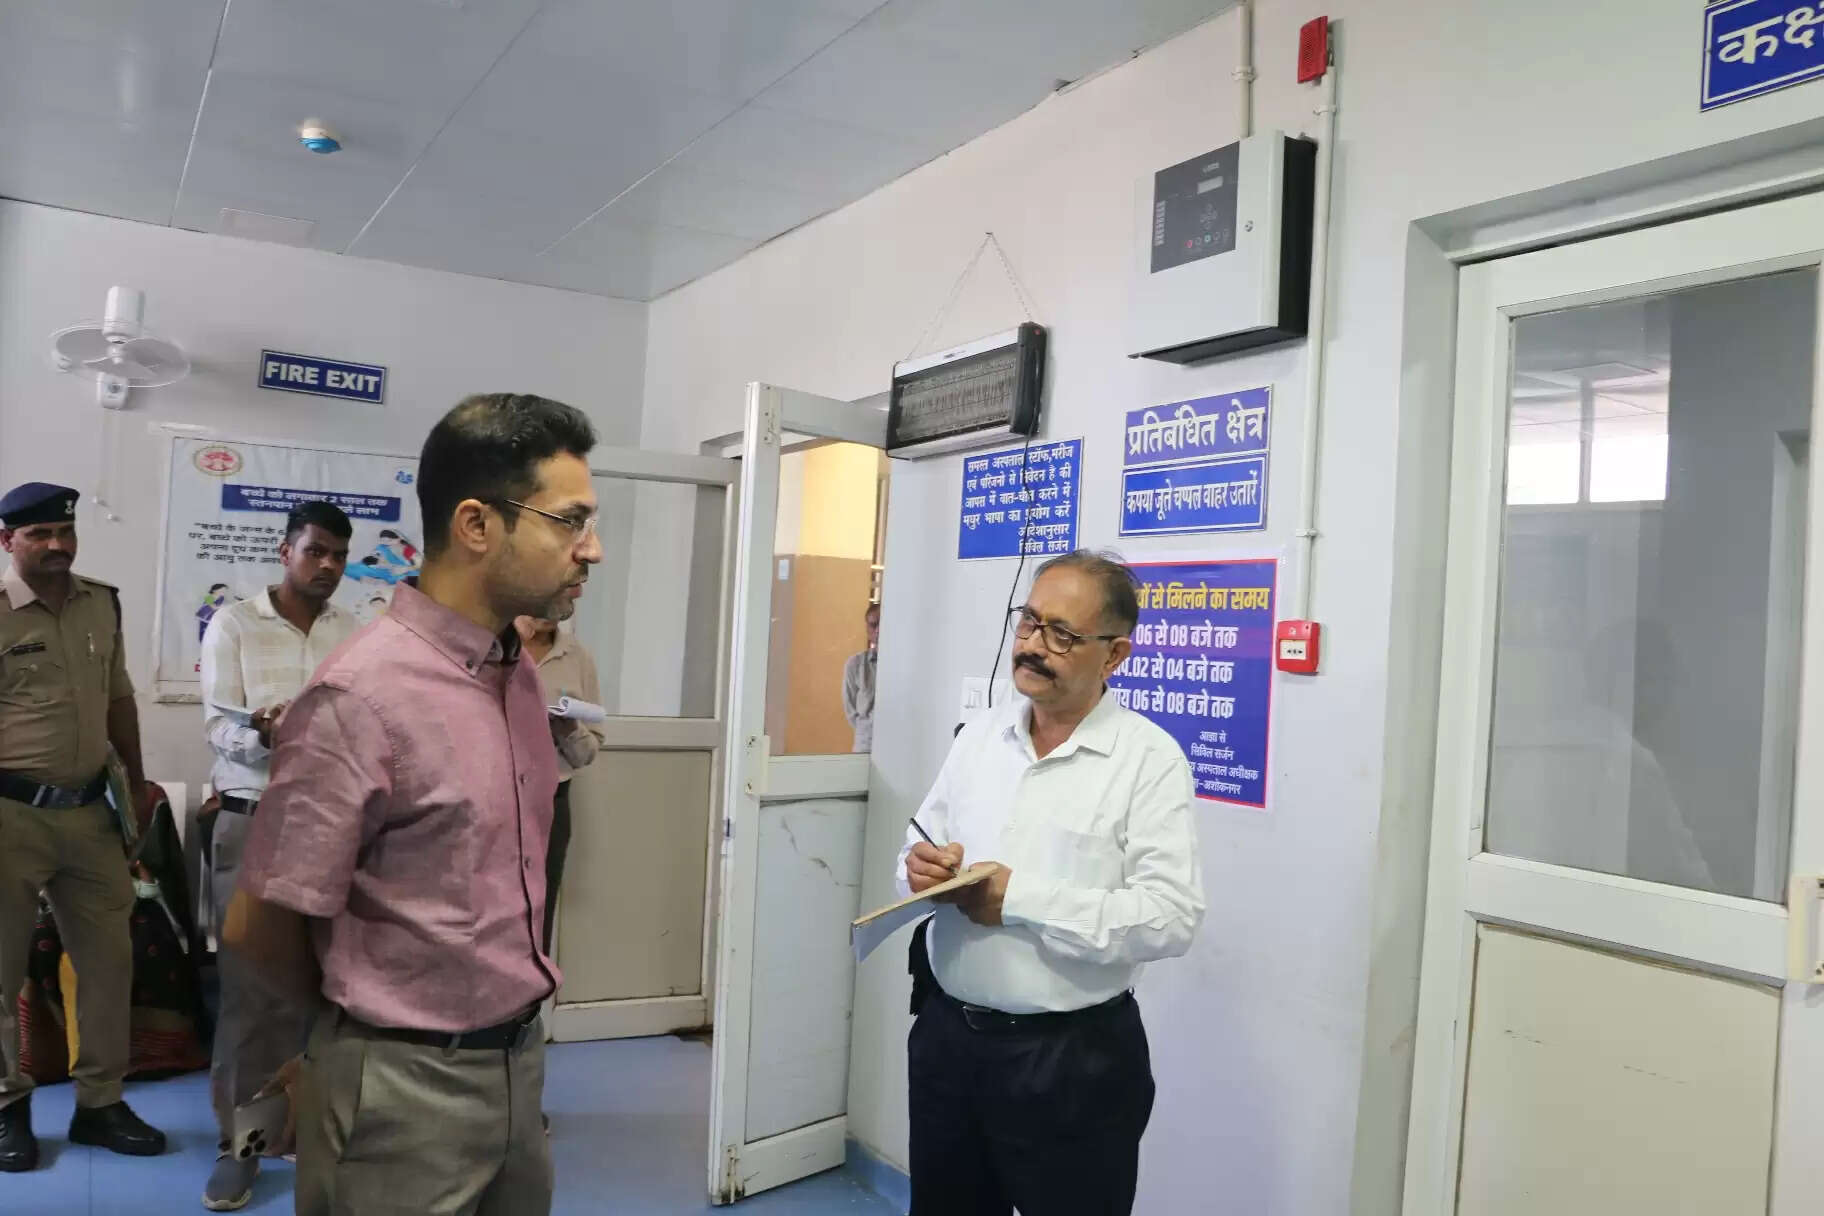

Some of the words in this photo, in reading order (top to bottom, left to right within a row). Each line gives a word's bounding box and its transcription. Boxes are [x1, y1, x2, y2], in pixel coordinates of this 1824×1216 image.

[265, 361, 319, 384] FIRE
[326, 370, 380, 392] EXIT
[1226, 399, 1265, 444] क्षेत्र
[1009, 470, 1016, 484] से
[1060, 462, 1072, 478] की
[1039, 483, 1059, 499] करने
[1063, 482, 1072, 497] में
[1154, 478, 1173, 520] जूते
[1229, 470, 1258, 506] उतारें
[1008, 509, 1021, 521] का
[1151, 582, 1165, 609] से
[1167, 582, 1208, 610] मिलने
[1209, 588, 1228, 610] का
[1231, 588, 1270, 611] समय
[1136, 624, 1152, 646] 06
[1154, 619, 1169, 646] से
[1170, 625, 1187, 647] 08
[1189, 619, 1213, 648] बजे
[1214, 626, 1239, 649] तक
[1151, 652, 1166, 679] से
[1166, 659, 1184, 681] 04
[1186, 654, 1210, 682] बजे
[1210, 661, 1235, 683] तक
[1132, 688, 1149, 711] 06
[1151, 685, 1166, 713] से
[1167, 691, 1185, 715] 08
[1186, 689, 1211, 717] बजे
[1211, 697, 1236, 719] तक
[1219, 730, 1227, 743] से
[1191, 743, 1213, 758] सिविल
[1215, 746, 1234, 760] सर्जन
[1197, 763, 1227, 776] अस्पताल
